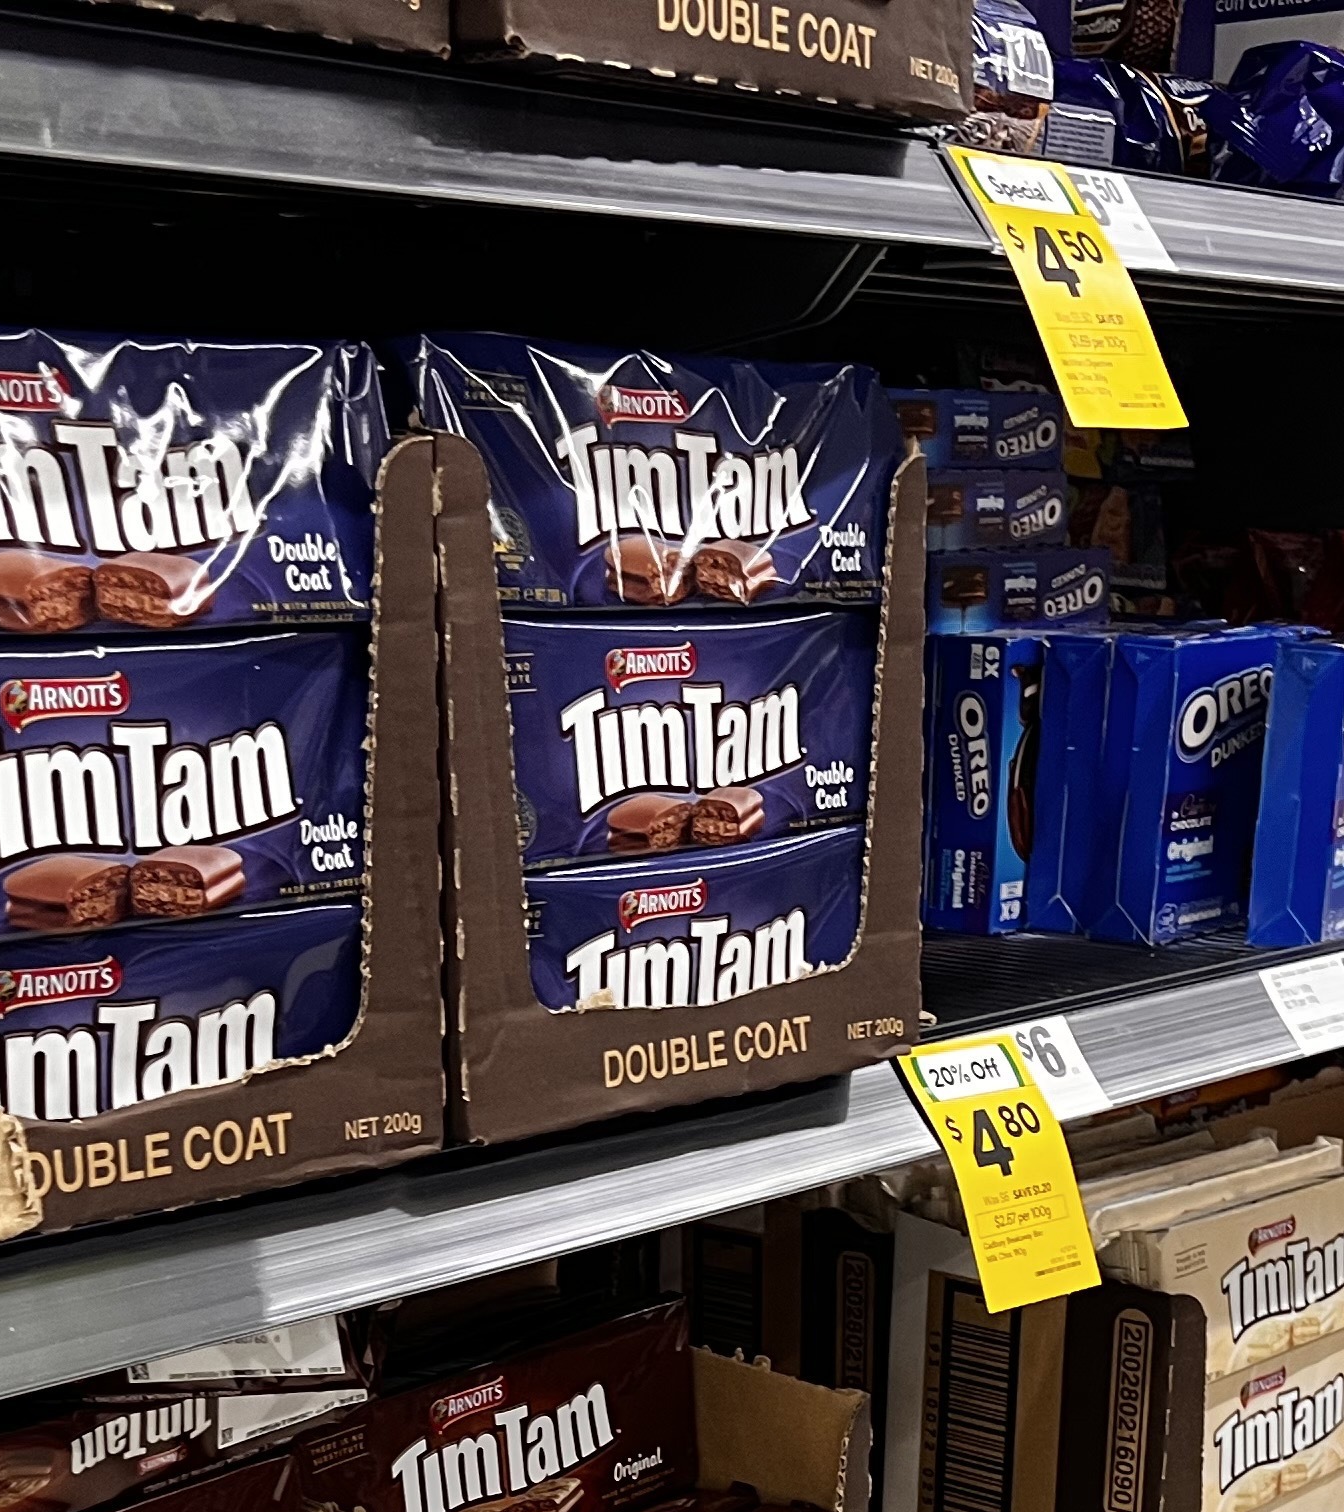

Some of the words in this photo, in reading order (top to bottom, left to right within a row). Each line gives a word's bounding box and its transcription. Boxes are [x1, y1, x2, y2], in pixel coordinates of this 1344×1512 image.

[657, 0, 792, 53] DOUBLE
[799, 14, 877, 70] COAT
[987, 174, 1054, 203] Special
[557, 425, 816, 547] TimTam
[266, 533, 340, 566] Double
[285, 563, 334, 594] Coat
[625, 651, 692, 676] ARNOTT'S
[26, 681, 122, 713] ARNOTT'S
[560, 684, 808, 814] TimTam
[959, 695, 991, 817] OREO
[805, 761, 855, 789] Double
[947, 733, 966, 802] DUNKED
[815, 786, 850, 810] Coat
[299, 812, 359, 848] Double
[310, 845, 355, 874] Coat
[953, 848, 966, 909] Original
[636, 888, 704, 916] ARNOTT'S
[565, 905, 806, 1010] TimTam
[17, 964, 115, 998] ARNOTT'S
[846, 1020, 874, 1041] NET
[874, 1016, 905, 1039] 200g
[603, 1030, 727, 1089] DOUBLE
[732, 1015, 812, 1062] COAT
[1015, 1024, 1067, 1079] $6
[928, 1063, 971, 1089] 20%
[183, 1113, 294, 1170] COAT
[343, 1118, 378, 1141] NET
[381, 1112, 424, 1139] 200g
[1030, 1204, 1053, 1220] 100g
[446, 1382, 505, 1419] ARNOTT'S
[1113, 1324, 1146, 1507] 200280216090
[612, 1446, 664, 1483] Original
